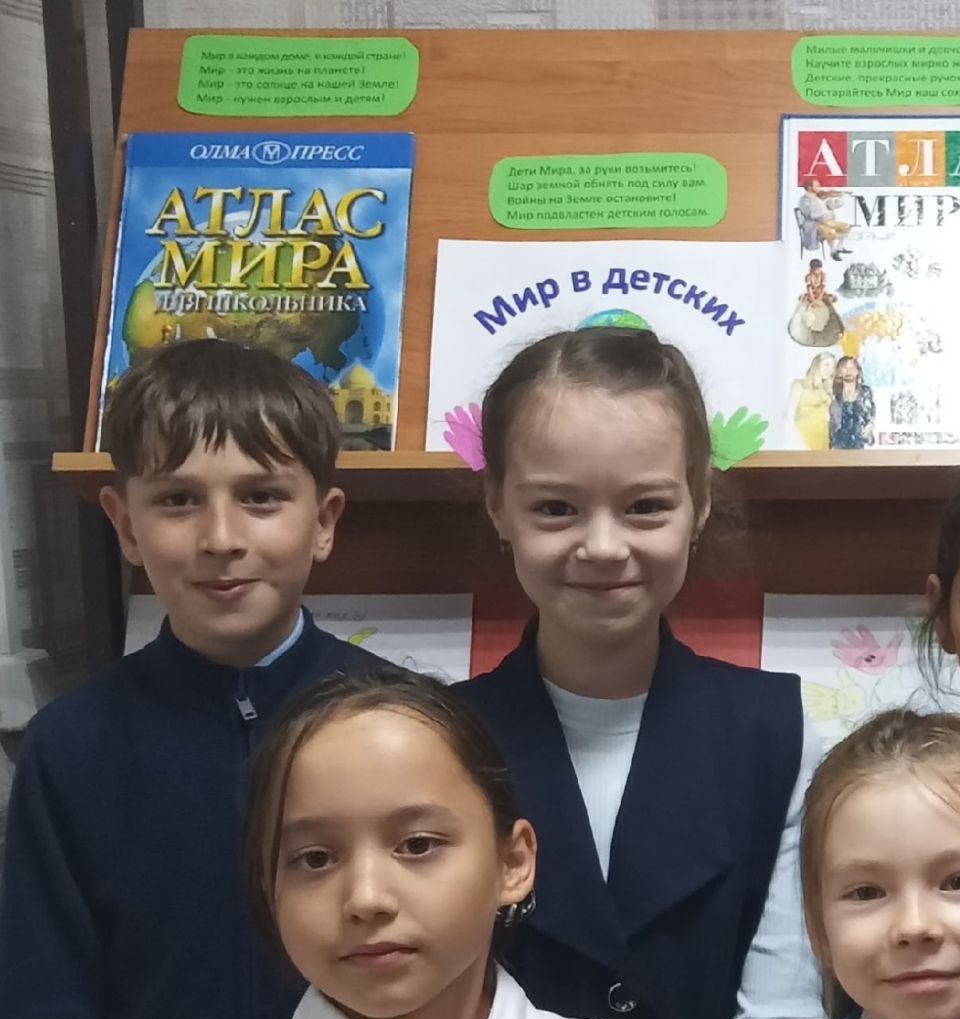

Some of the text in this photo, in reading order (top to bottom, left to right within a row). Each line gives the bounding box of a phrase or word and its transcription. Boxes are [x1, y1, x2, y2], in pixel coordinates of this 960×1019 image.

[201, 51, 226, 61] Мир
[236, 53, 279, 61] каждом
[323, 51, 364, 61] каждой
[365, 51, 406, 61] стране!
[806, 46, 847, 54] Милые
[850, 46, 915, 54] мальчишки
[918, 46, 925, 54] и
[806, 59, 850, 69] Научите
[854, 59, 907, 69] взрослых
[912, 60, 949, 69] мирно
[199, 66, 225, 76] Мир
[313, 66, 365, 75] планете!
[197, 80, 399, 90] Мир это солнце на нашей Земле!
[858, 75, 927, 83] прекрасные
[196, 93, 385, 105] Мир нужен взрослым и детям!
[805, 88, 883, 98] Постарайтесь
[886, 88, 912, 98] Мир
[915, 89, 939, 97] наш
[190, 144, 365, 161] ОЛМА ПРЕСС
[508, 167, 536, 177] Дети
[578, 167, 591, 175] за
[594, 166, 621, 176] руки
[625, 163, 696, 174] возьмитесь!
[507, 181, 534, 192] Шар
[536, 180, 580, 190] земной
[583, 178, 624, 189] обнять
[627, 179, 649, 189] под
[652, 178, 678, 189] силу
[507, 192, 677, 205] Войны на Земле остановите!
[144, 186, 387, 239] АТЛАС
[507, 210, 534, 221] Мир
[536, 210, 604, 220] подвластен
[608, 208, 656, 218] детским
[153, 239, 374, 290] МИРА
[473, 268, 746, 336] Мир в детских
